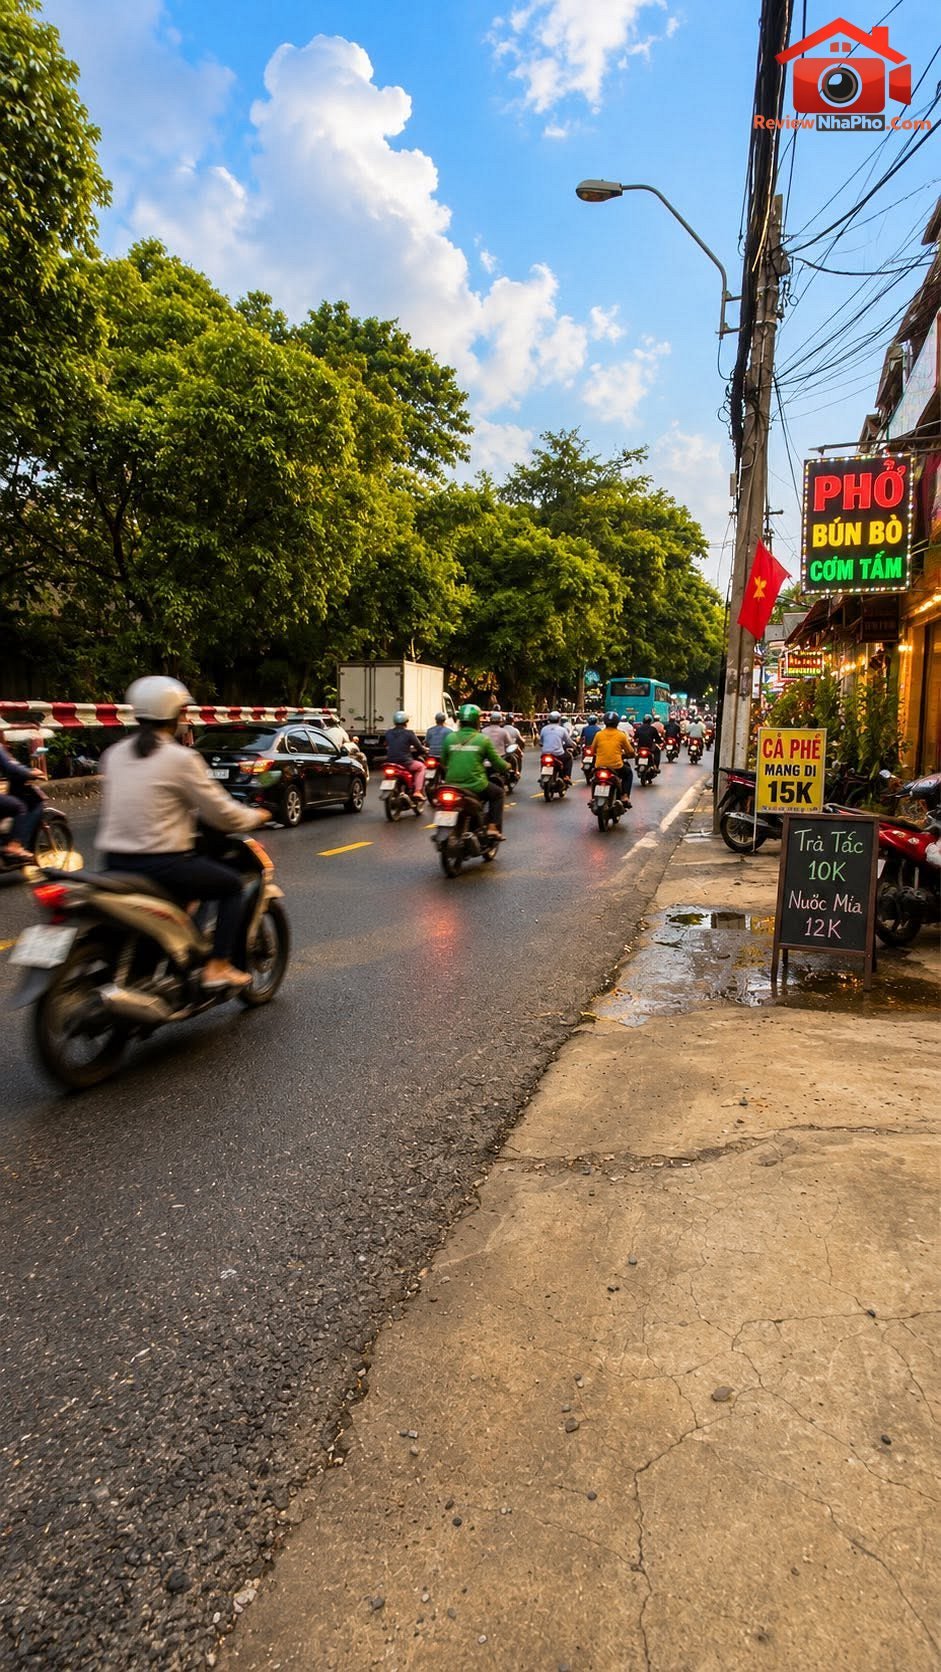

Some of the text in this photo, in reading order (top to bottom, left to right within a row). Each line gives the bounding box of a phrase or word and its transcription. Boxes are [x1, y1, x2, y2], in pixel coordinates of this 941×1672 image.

[813, 458, 907, 512] PHỞ
[812, 514, 903, 548] BÚN BÒ
[810, 550, 903, 582] CƠM TẤM
[765, 764, 800, 776] MANG
[768, 781, 813, 804] 15K
[808, 860, 847, 882] 10K
[804, 917, 842, 939] 12K
